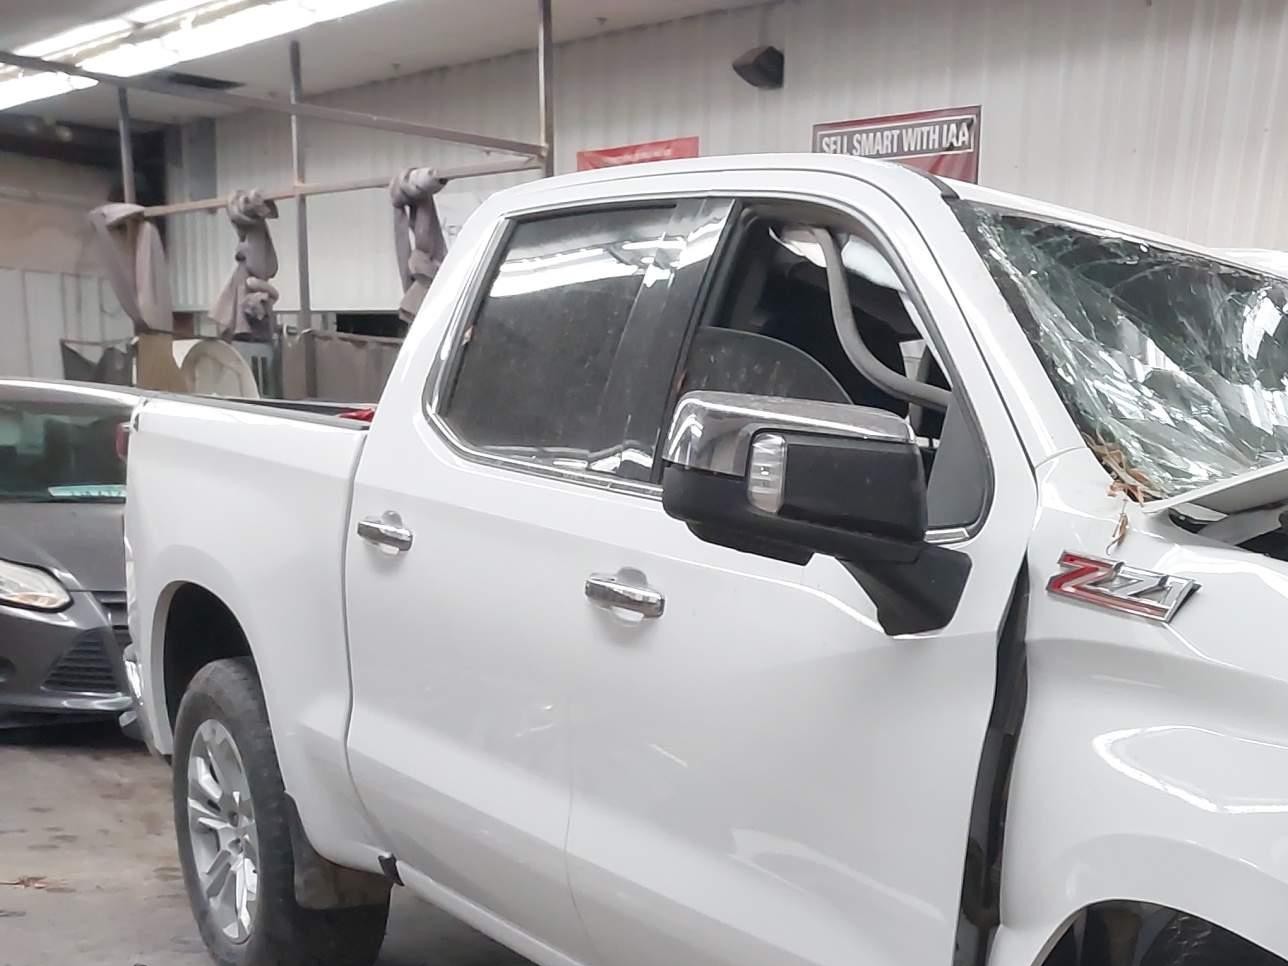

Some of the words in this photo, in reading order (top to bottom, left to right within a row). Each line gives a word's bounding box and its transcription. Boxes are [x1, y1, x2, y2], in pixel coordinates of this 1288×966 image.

[822, 135, 848, 154] SELL
[852, 130, 900, 156] SMART
[902, 124, 939, 152] WITH
[942, 122, 969, 148] IAA
[1046, 550, 1202, 624] Z71
